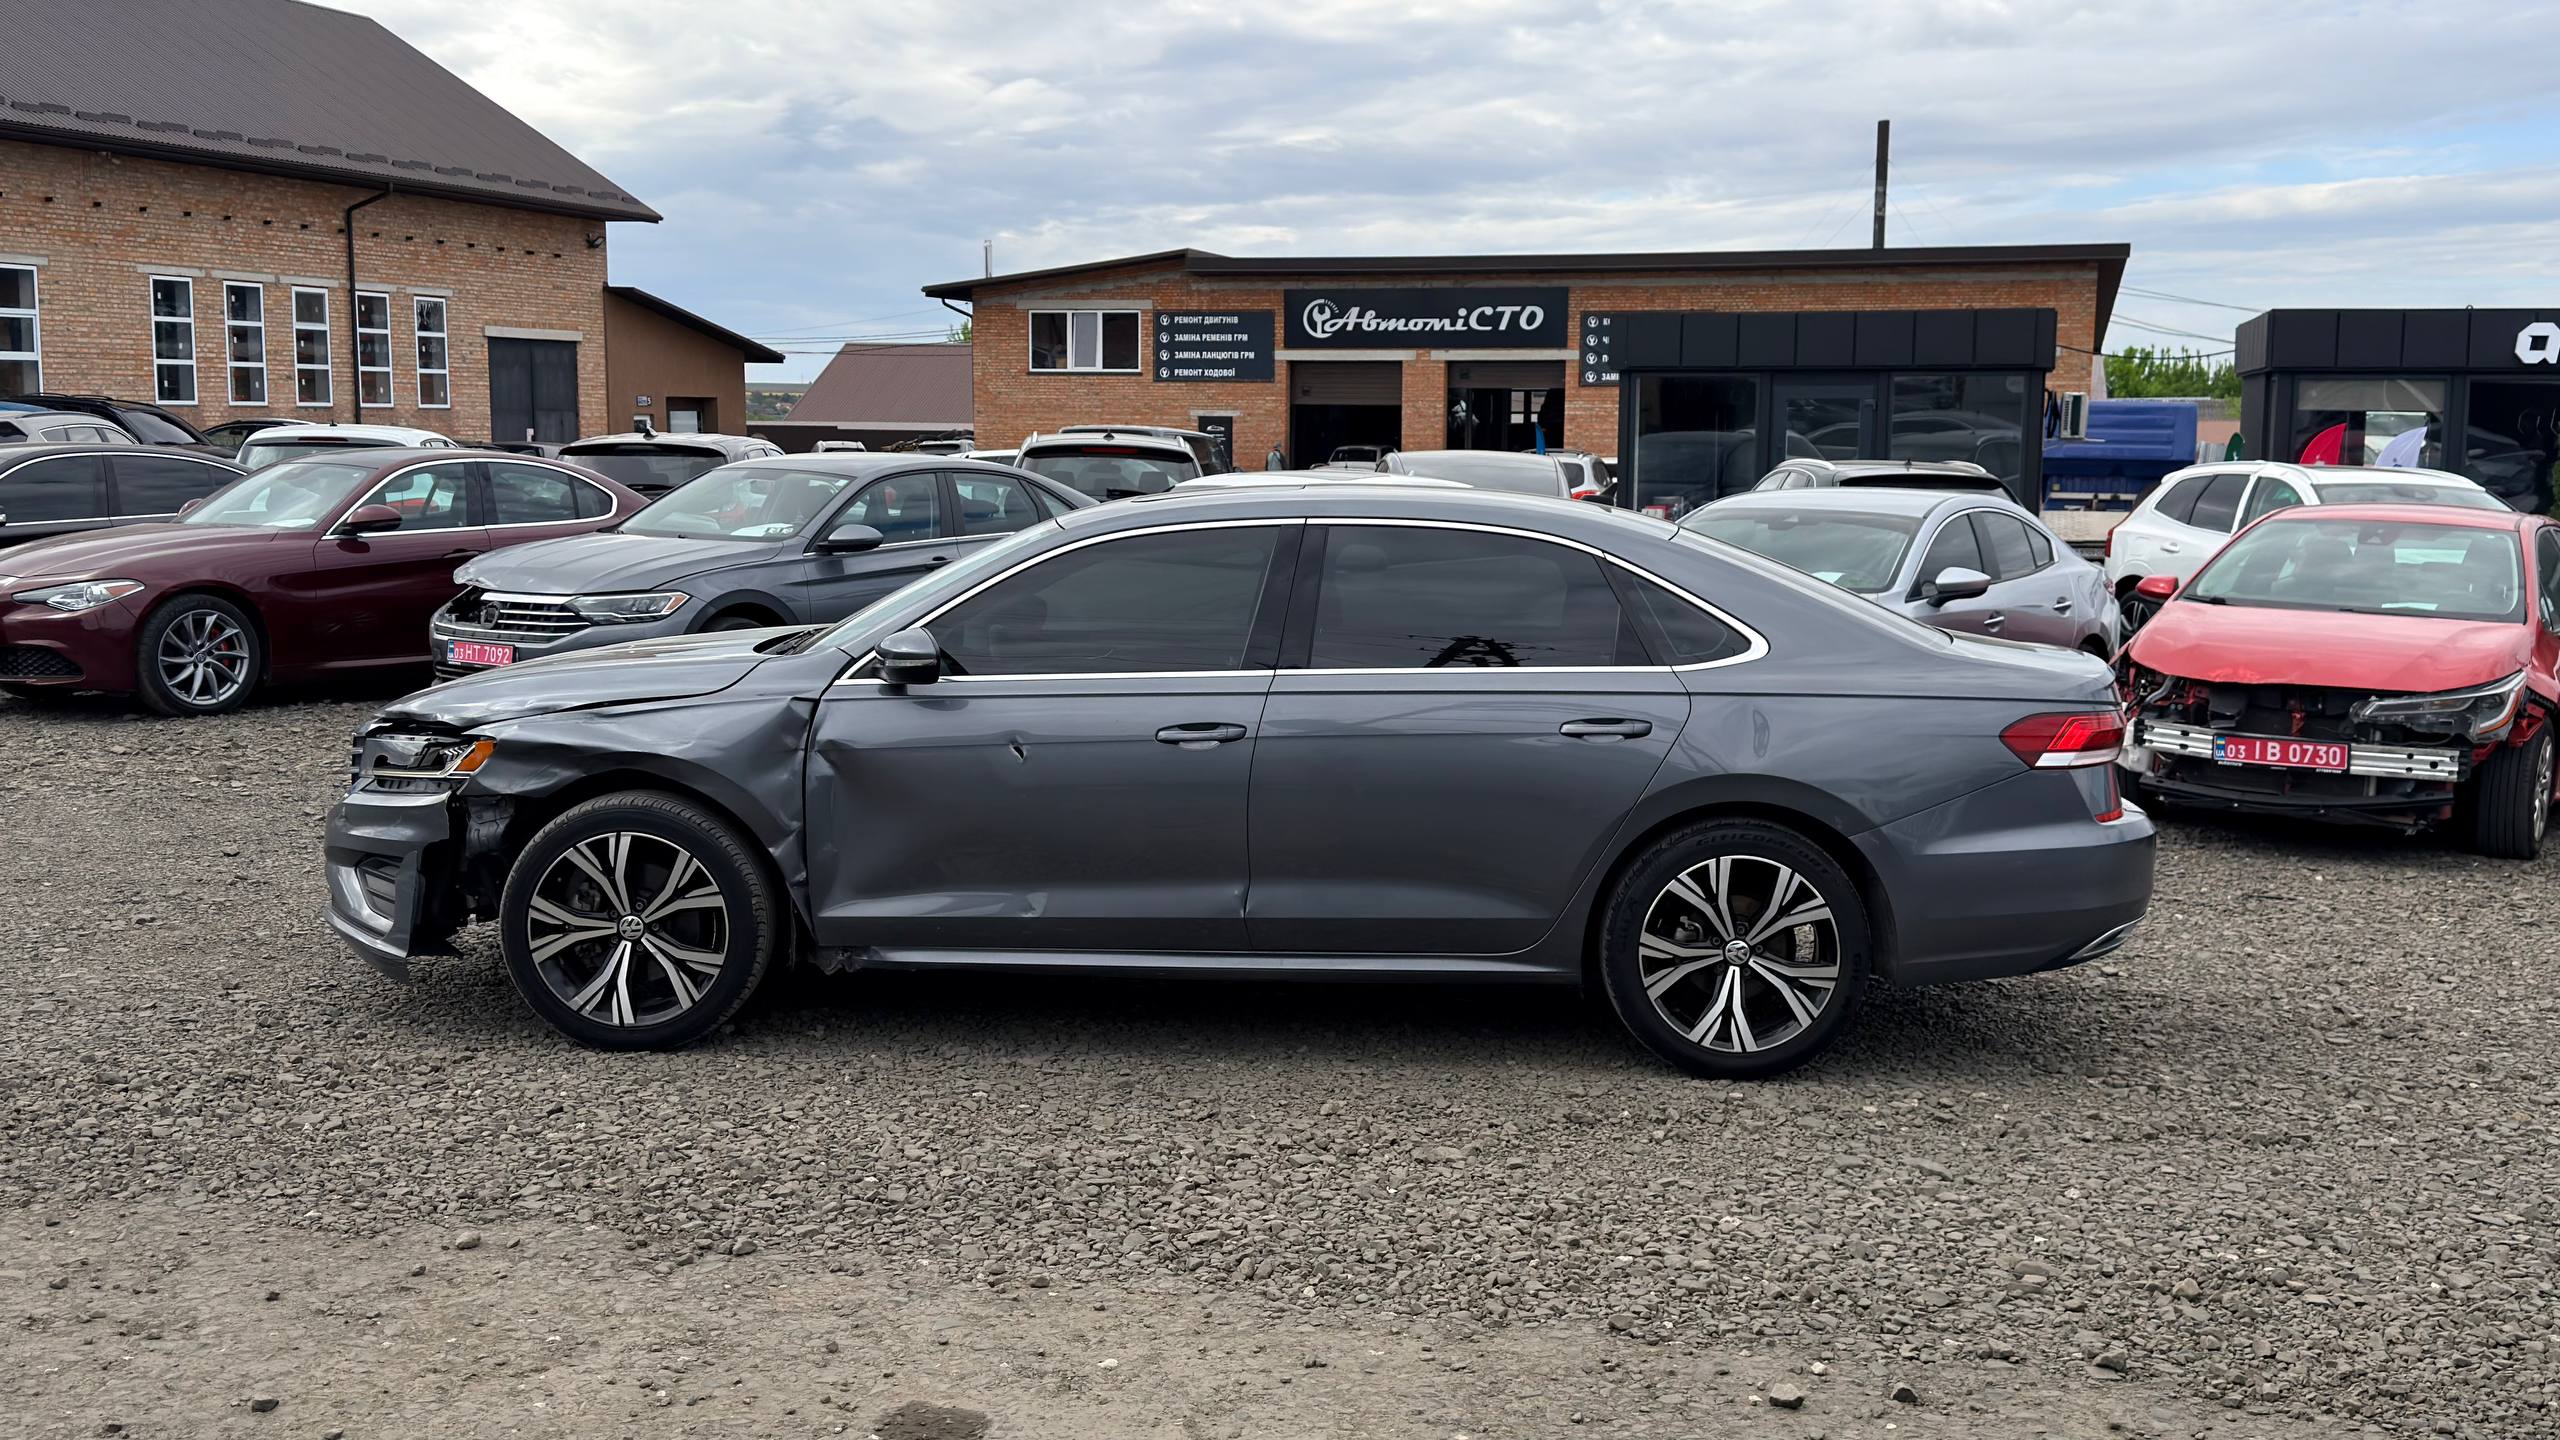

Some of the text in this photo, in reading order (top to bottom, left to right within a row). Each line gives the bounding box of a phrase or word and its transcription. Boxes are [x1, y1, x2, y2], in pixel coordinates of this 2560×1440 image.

[1174, 316, 1239, 325] РЕМОНТ ДВИГУНІВ
[1174, 333, 1248, 342] ЗАМІНА РЕМЕНІВ ГРМ
[1174, 351, 1255, 360] ЗАМІНА ЛАНЦЮГІВ ГРМ
[1174, 367, 1236, 378] РЕМОНТ ХОДОВОЇ
[454, 644, 510, 664] 03 HT 7092
[2227, 744, 2246, 759] 03
[2288, 743, 2341, 766] 0730
